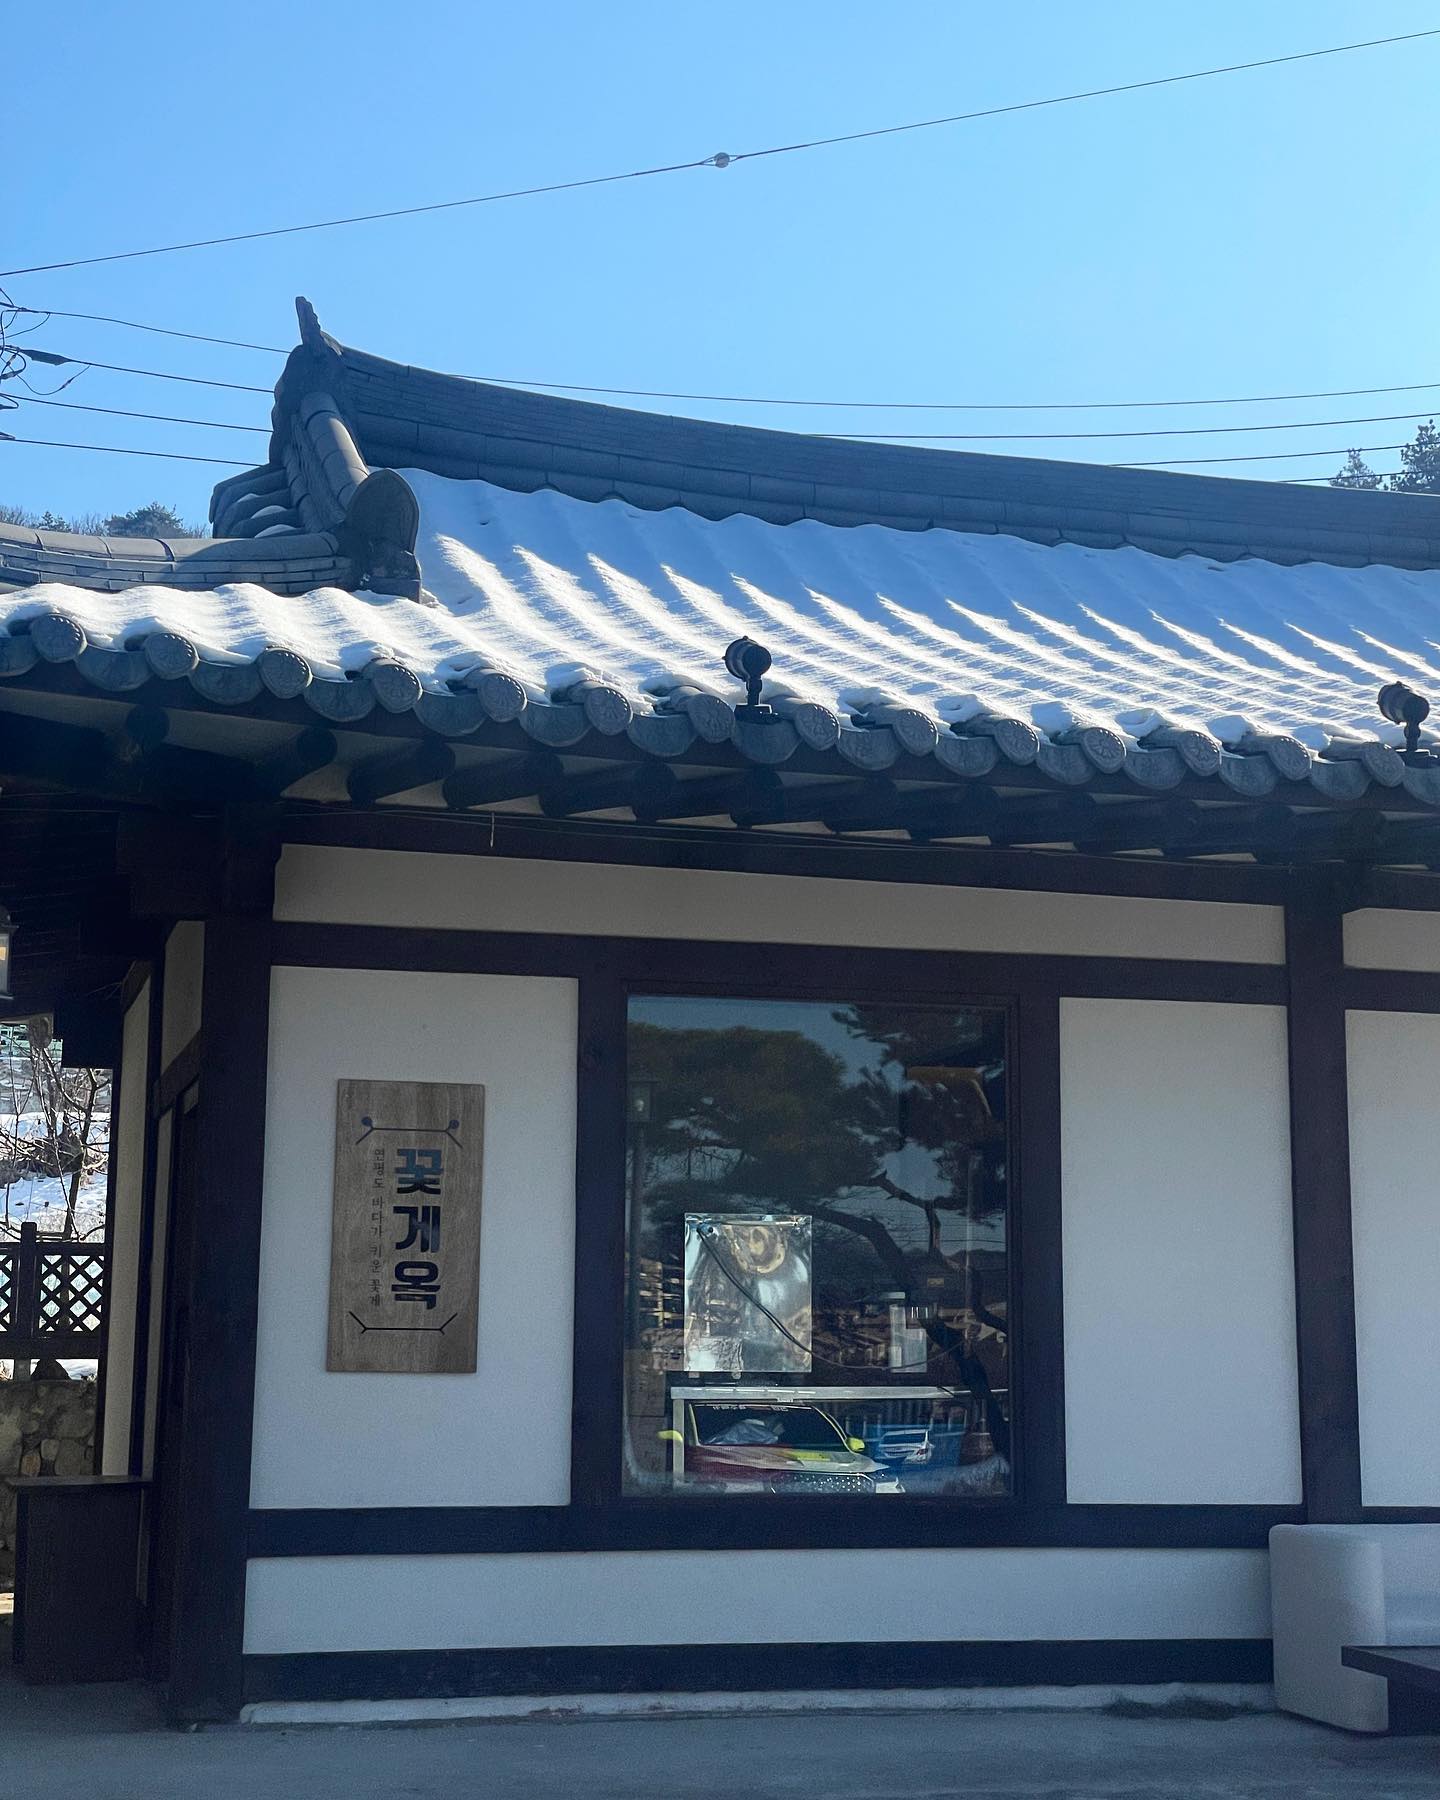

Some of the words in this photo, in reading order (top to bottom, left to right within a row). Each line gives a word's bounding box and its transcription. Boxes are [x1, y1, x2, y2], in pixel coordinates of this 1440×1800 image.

[371, 1148, 385, 1189] 연평도
[370, 1196, 384, 1237] 바다가
[391, 1148, 444, 1310] 꽃게옥
[368, 1245, 382, 1274] 키운
[367, 1279, 382, 1307] 꽃게
